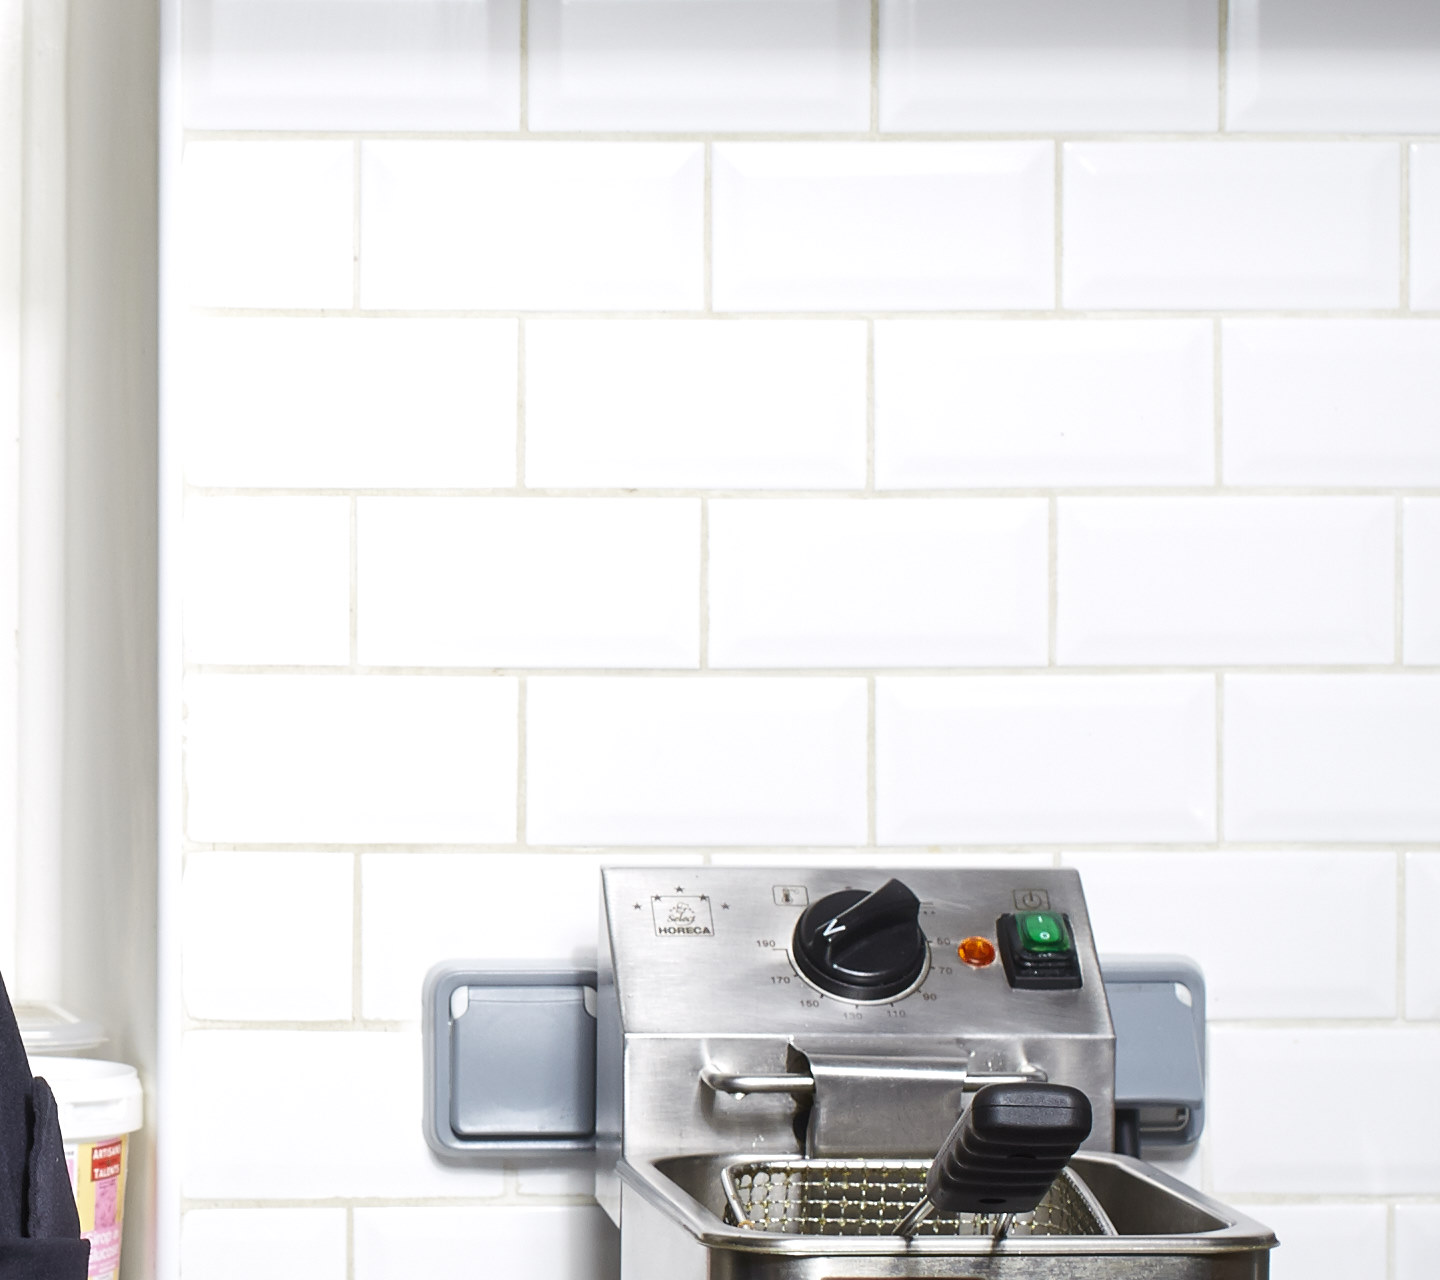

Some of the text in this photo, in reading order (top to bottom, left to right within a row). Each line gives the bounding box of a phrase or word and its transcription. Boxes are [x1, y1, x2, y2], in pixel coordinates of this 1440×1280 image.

[658, 926, 712, 935] HORECA
[756, 939, 776, 948] 190
[936, 937, 951, 946] 50
[939, 966, 953, 975] 70
[771, 976, 791, 985] 170
[923, 993, 937, 1002] 90
[799, 999, 820, 1008] 150
[843, 1012, 863, 1021] 130
[886, 1009, 906, 1018] 110
